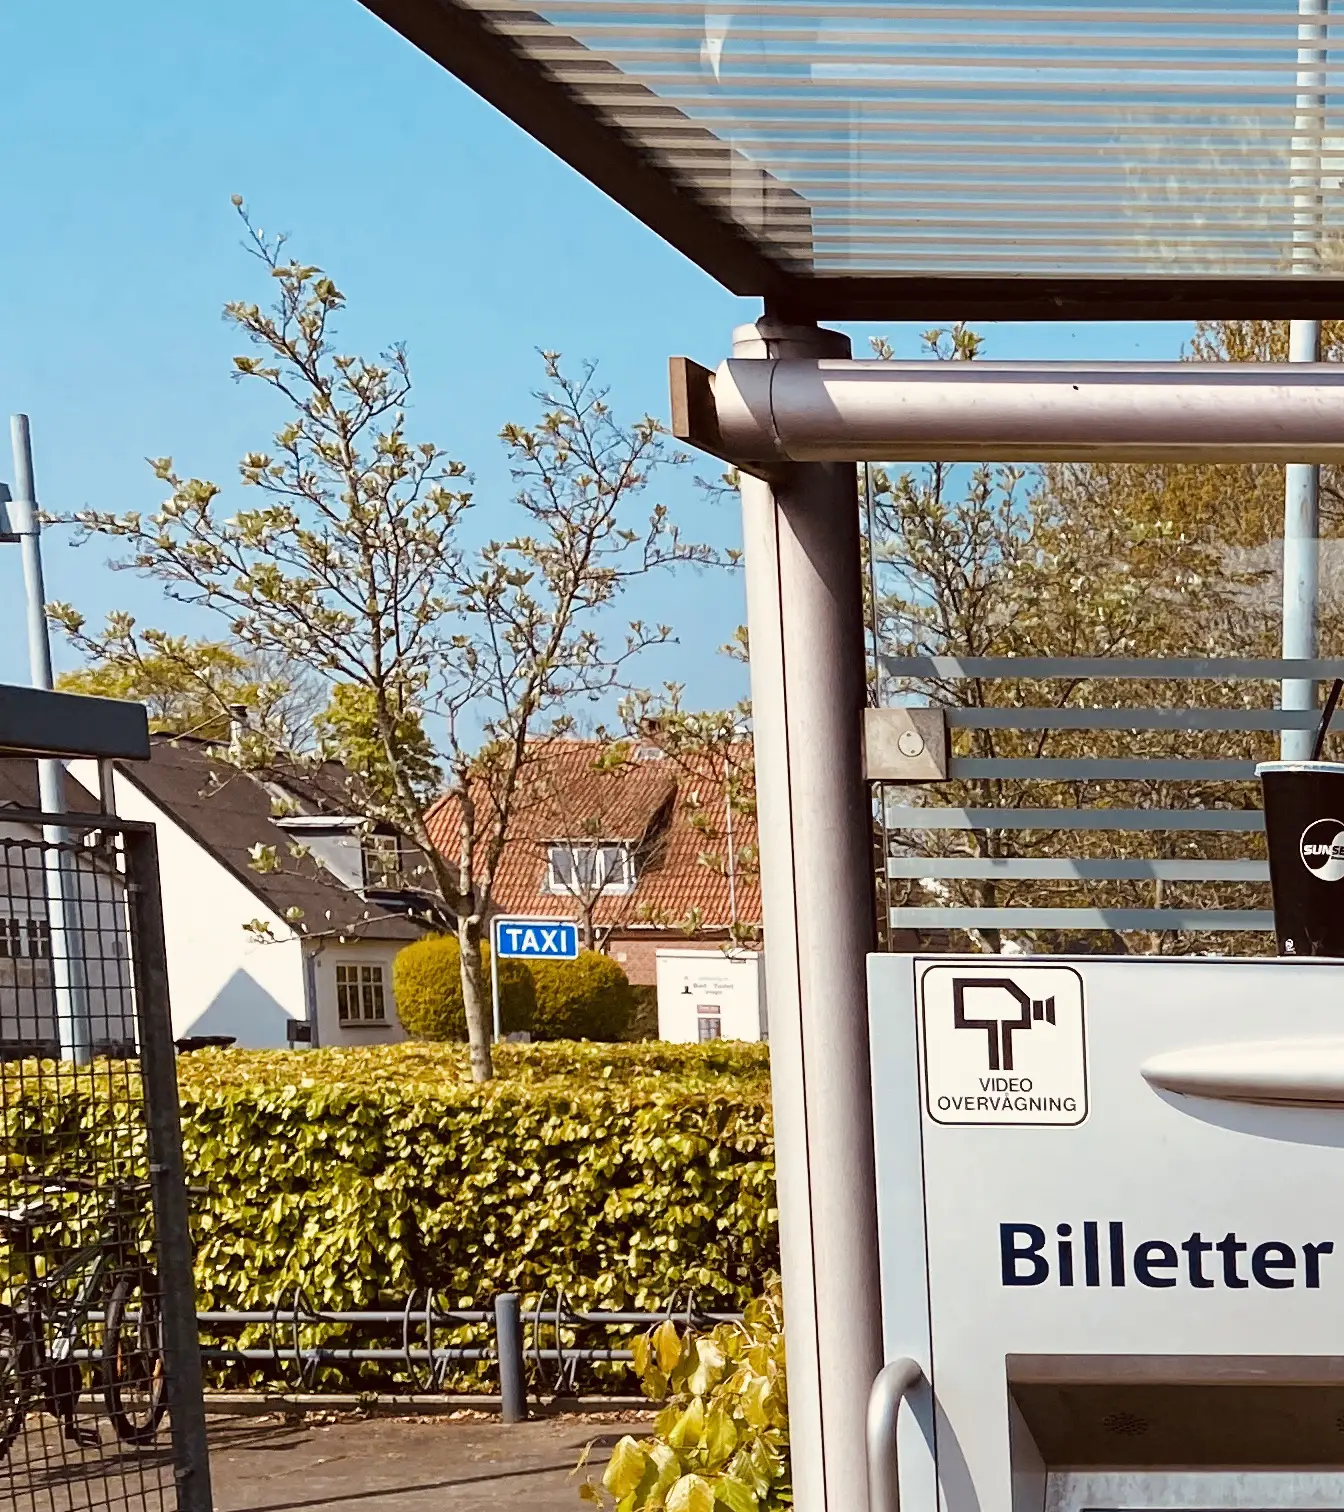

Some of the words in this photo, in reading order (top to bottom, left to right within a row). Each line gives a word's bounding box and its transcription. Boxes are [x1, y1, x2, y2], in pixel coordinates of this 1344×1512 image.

[505, 928, 567, 953] TAXI
[979, 1077, 1033, 1092] VIDEO
[937, 1093, 1077, 1112] OVERVÅGNING
[999, 1221, 1334, 1290] Billetter
